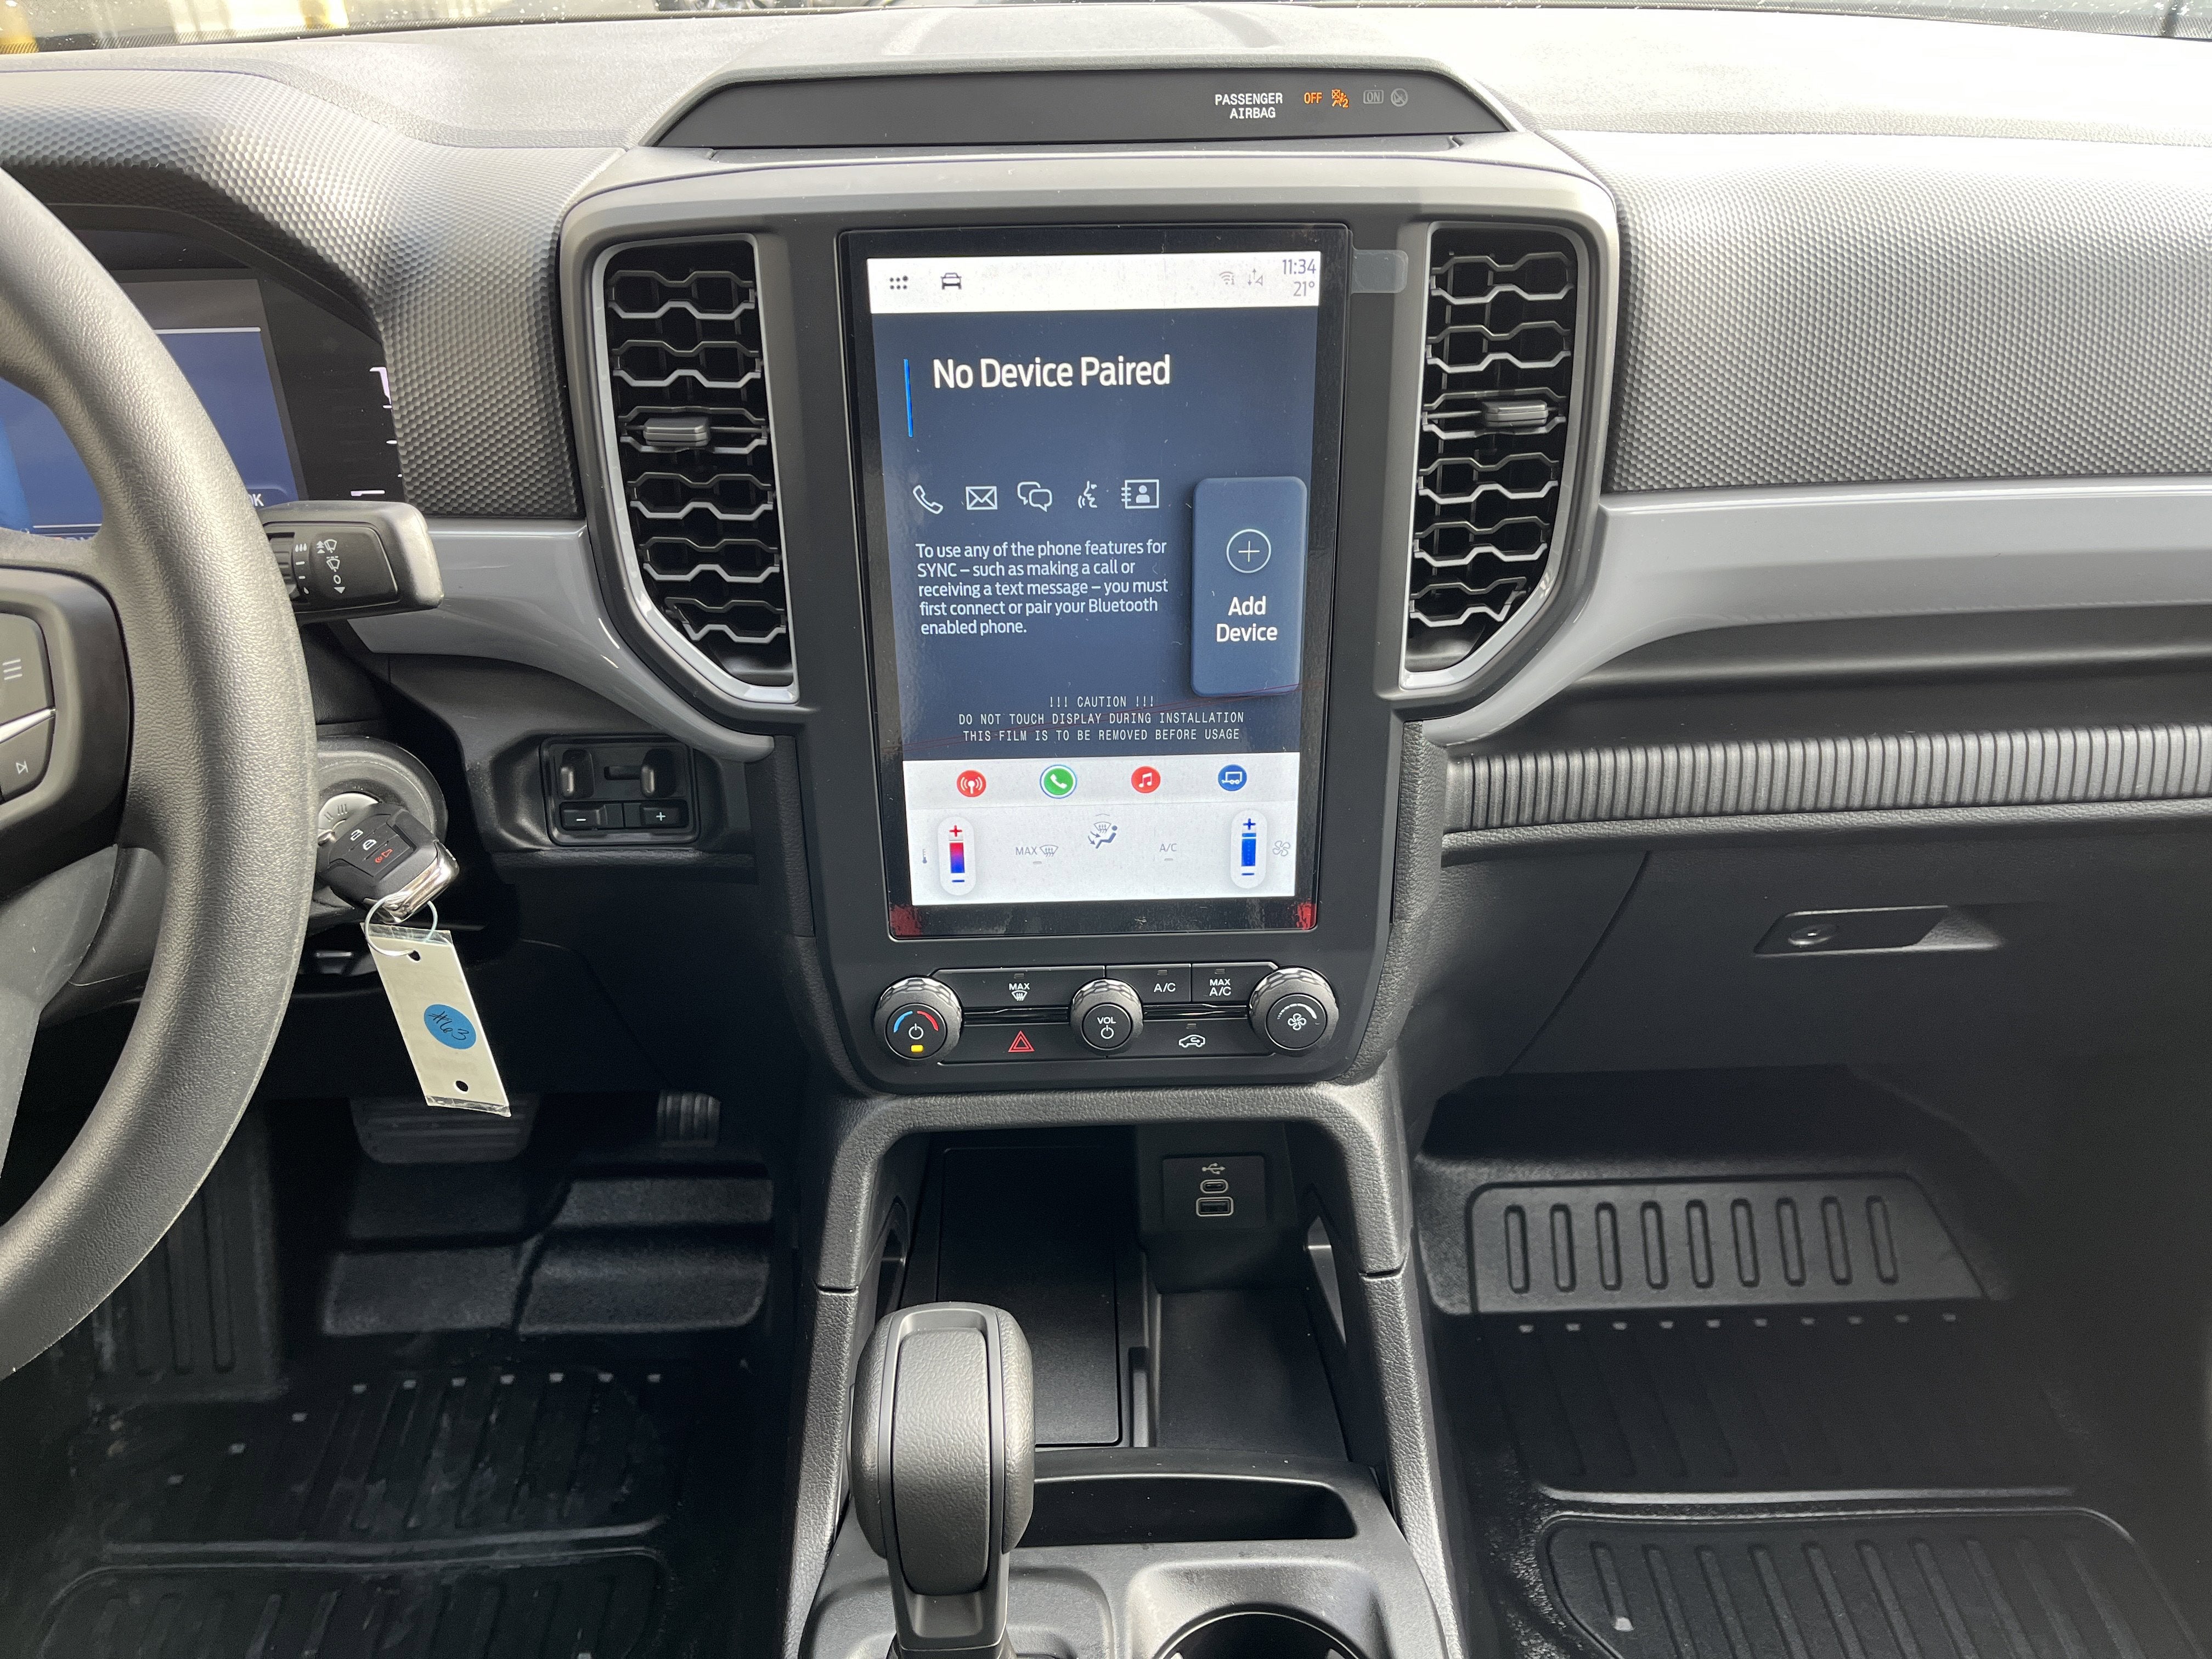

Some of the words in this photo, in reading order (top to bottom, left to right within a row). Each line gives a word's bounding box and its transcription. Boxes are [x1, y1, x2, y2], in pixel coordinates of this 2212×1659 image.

[1215, 92, 1283, 106] PASSENGER
[1304, 92, 1322, 104] OFF
[1367, 92, 1380, 103] ON
[1229, 106, 1276, 119] AIRBAG
[1282, 259, 1316, 275] 11:34
[1293, 281, 1315, 297] 21°
[933, 359, 973, 388] No
[980, 357, 1073, 388] Device
[1081, 354, 1170, 386] Paired
[916, 544, 934, 557] To
[936, 546, 961, 558] use
[964, 545, 990, 560] any
[992, 541, 1008, 557] of
[1010, 541, 1035, 557] the
[1037, 541, 1082, 558] phone
[1084, 541, 1144, 555] features
[1146, 539, 1167, 554] for
[917, 562, 957, 578] SYNC
[973, 561, 1005, 577] such
[1008, 565, 1024, 576] as
[1026, 561, 1079, 578] making
[1081, 563, 1091, 574] a
[1093, 558, 1119, 574] call
[1121, 562, 1136, 574] or
[918, 582, 981, 599] receiving
[983, 584, 992, 596] a
[994, 583, 1024, 596] text
[1027, 584, 1088, 595] message
[1103, 583, 1129, 594] you
[1133, 580, 1169, 593] must
[919, 602, 949, 617] first
[950, 602, 1006, 617] connect
[1008, 603, 1023, 614] or
[1025, 600, 1052, 616] pair
[1054, 601, 1086, 614] your
[1088, 597, 1158, 613] Bluetooth
[1228, 595, 1266, 616] Add
[921, 619, 977, 635] enabled
[980, 620, 1028, 636] phone.
[1216, 623, 1278, 642] Device
[1050, 696, 1068, 708] !!!
[1077, 696, 1126, 708] CAUTION
[1136, 696, 1153, 707] !!!
[958, 714, 973, 725] DO
[980, 713, 1001, 725] NOT
[1009, 713, 1044, 725] TOUCH
[1052, 713, 1102, 724] DISPLAY
[1109, 712, 1151, 724] DURING
[1159, 712, 1244, 724] INSTALLATION
[963, 730, 991, 742] THIS
[999, 730, 1027, 741] FILM
[1035, 730, 1048, 741] IS
[1056, 730, 1069, 741] TO
[1077, 730, 1091, 741] BE
[1099, 729, 1147, 741] REMOVED
[1155, 728, 1197, 740] BEFORE
[1205, 728, 1239, 740] USAGE
[1015, 846, 1037, 855] MAX
[1159, 843, 1177, 853] A/C
[1008, 983, 1030, 991] MAX
[1153, 983, 1176, 992] A/C
[1209, 978, 1231, 987] MAX
[1209, 987, 1232, 997] A/C
[428, 1010, 470, 1041] #63
[1097, 1016, 1116, 1025] VOL
